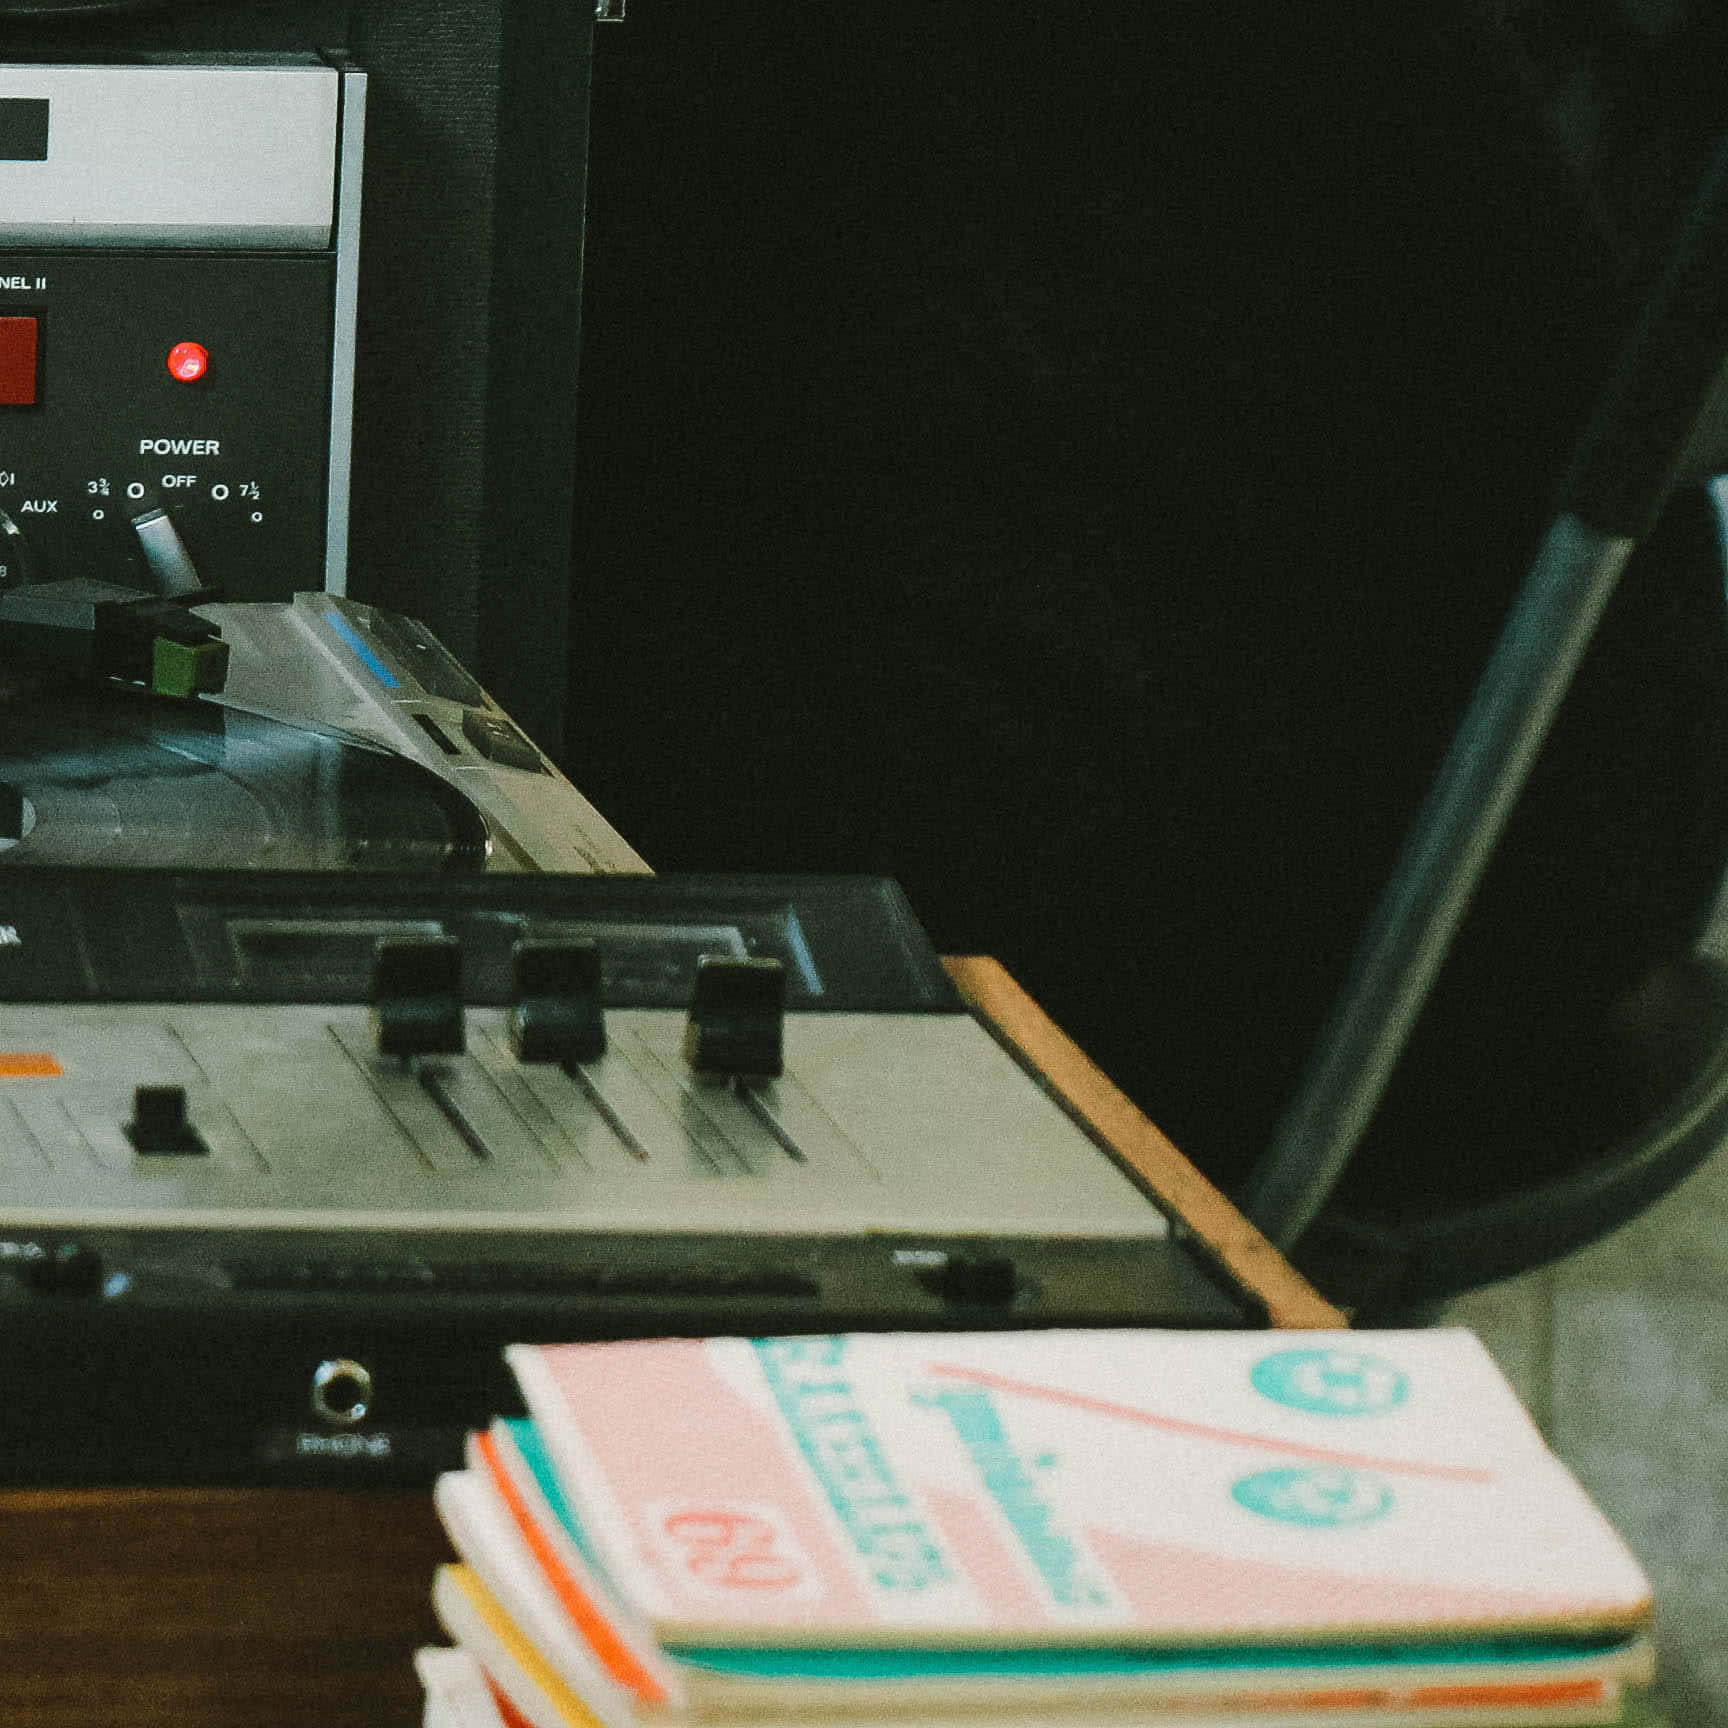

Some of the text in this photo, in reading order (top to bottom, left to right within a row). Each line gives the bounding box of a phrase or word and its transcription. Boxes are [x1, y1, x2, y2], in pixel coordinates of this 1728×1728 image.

[139, 438, 221, 456] POWER
[161, 474, 197, 489] OFF
[20, 499, 59, 514] AUX
